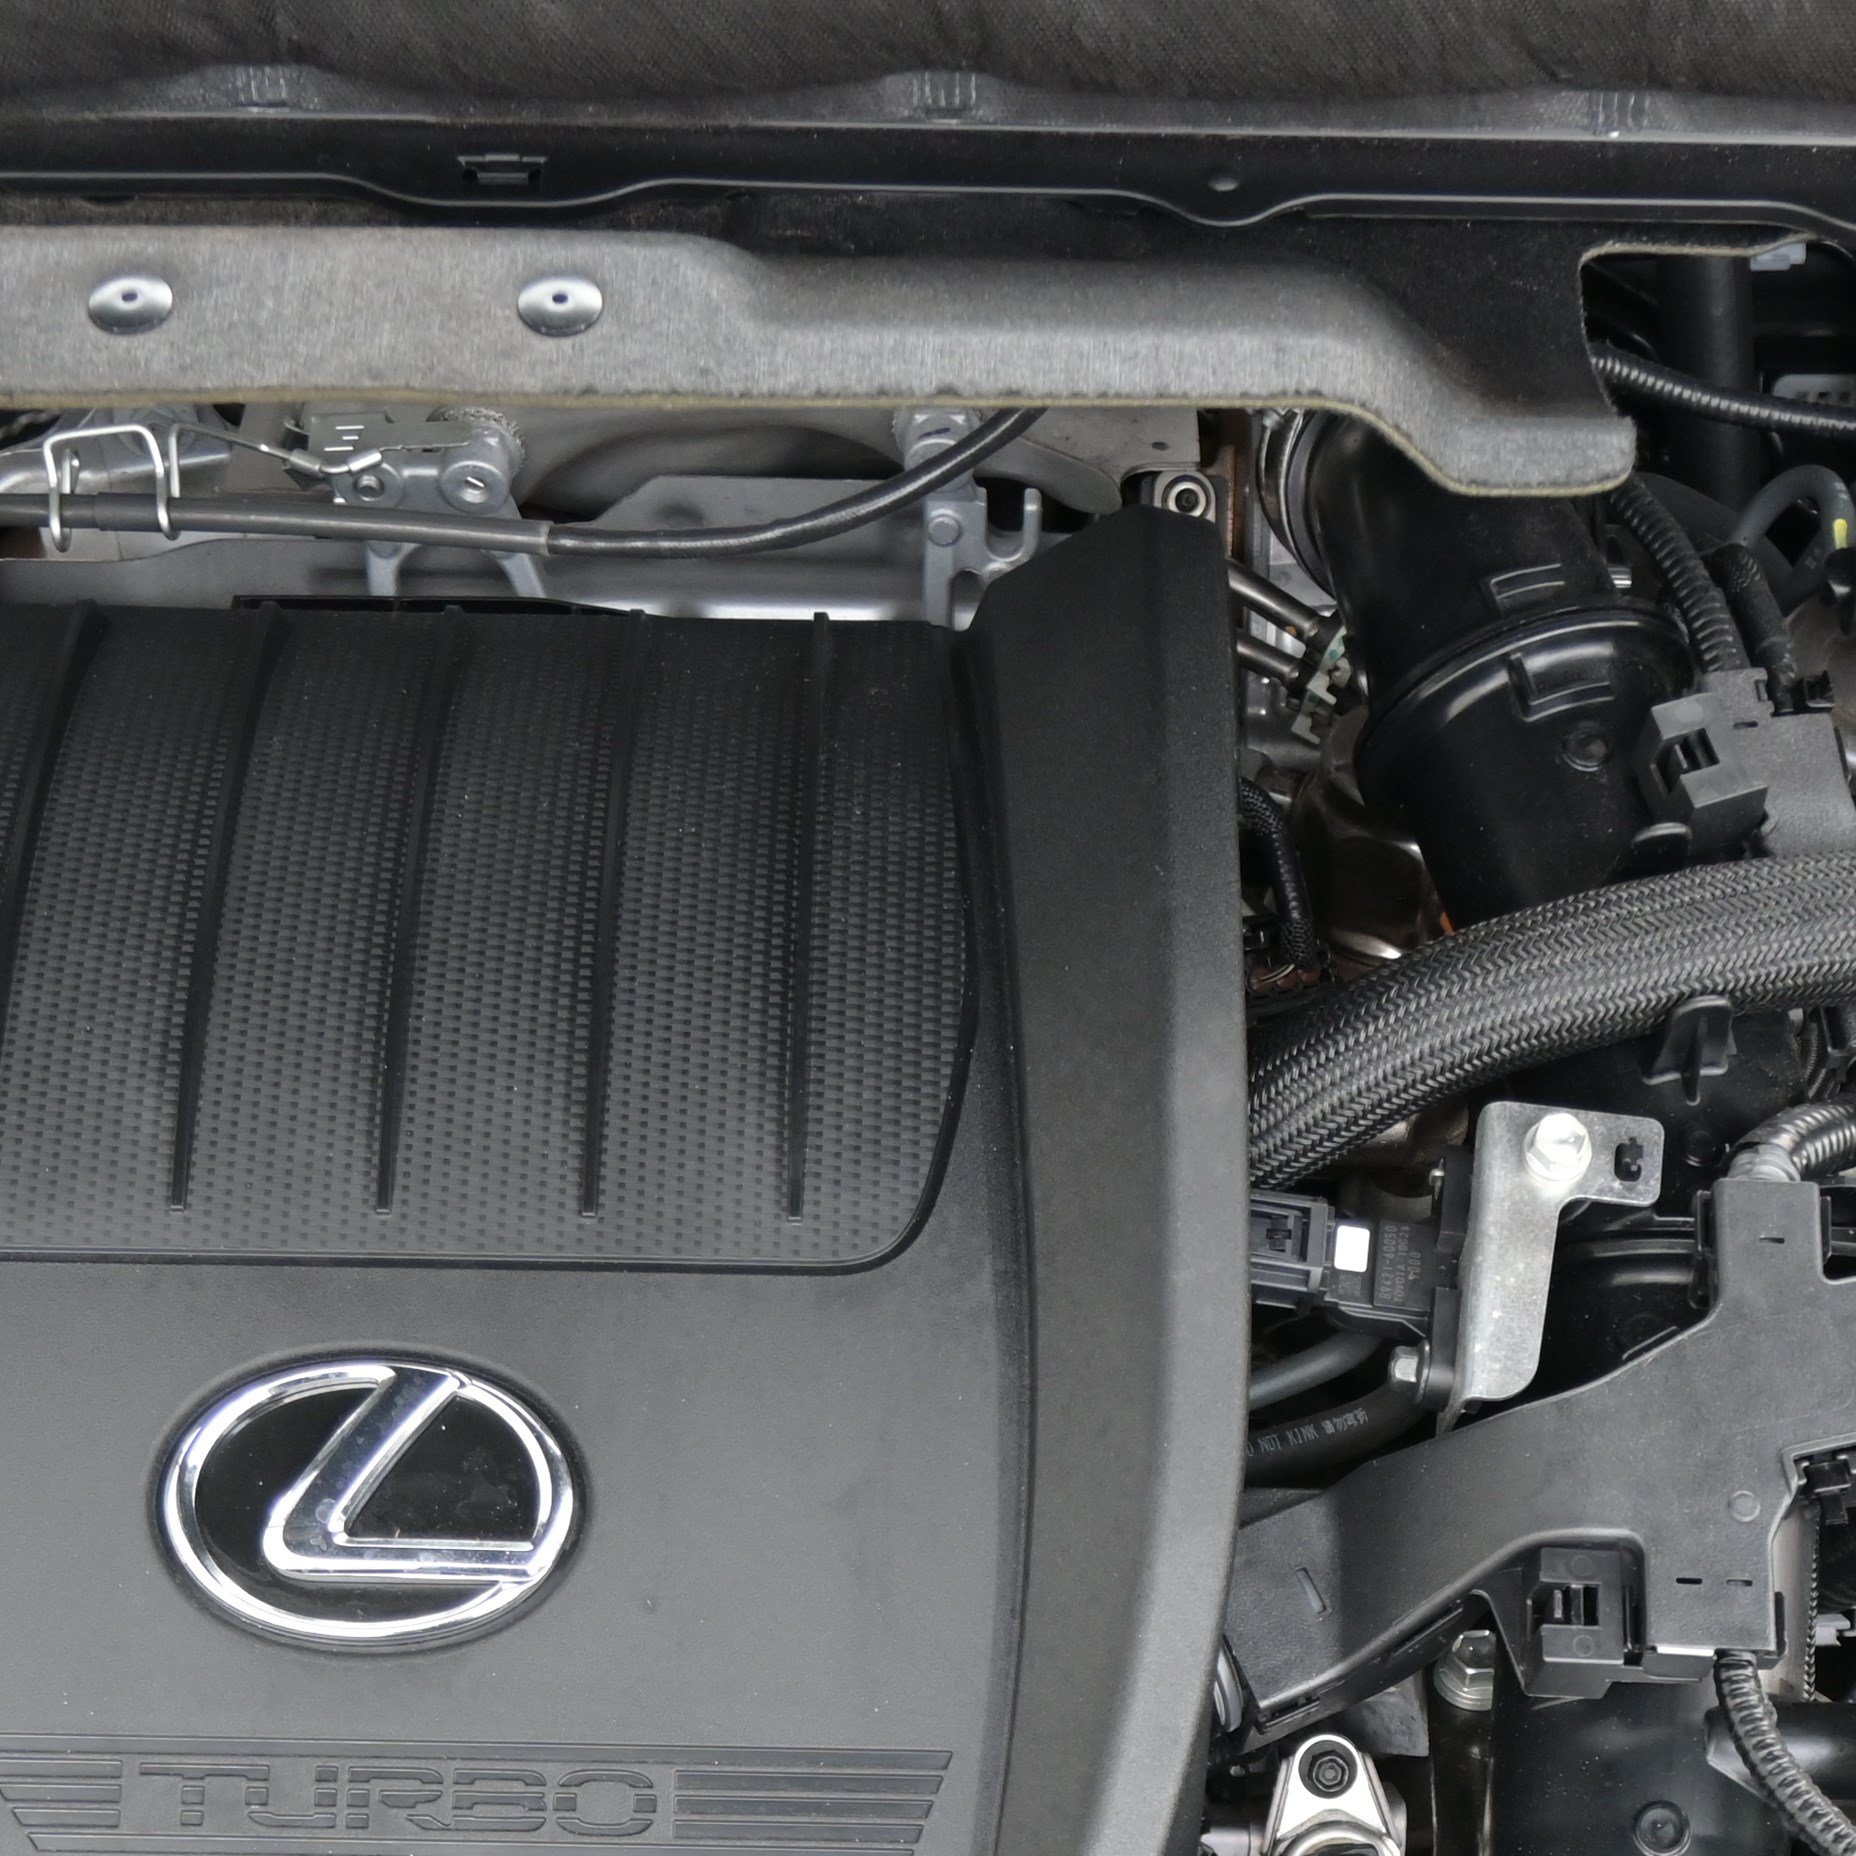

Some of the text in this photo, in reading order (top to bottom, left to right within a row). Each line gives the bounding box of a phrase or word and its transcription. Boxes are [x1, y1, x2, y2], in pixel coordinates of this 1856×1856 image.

[1257, 1423, 1319, 1452] NOT KINK
[137, 1760, 659, 1838] TURBO
